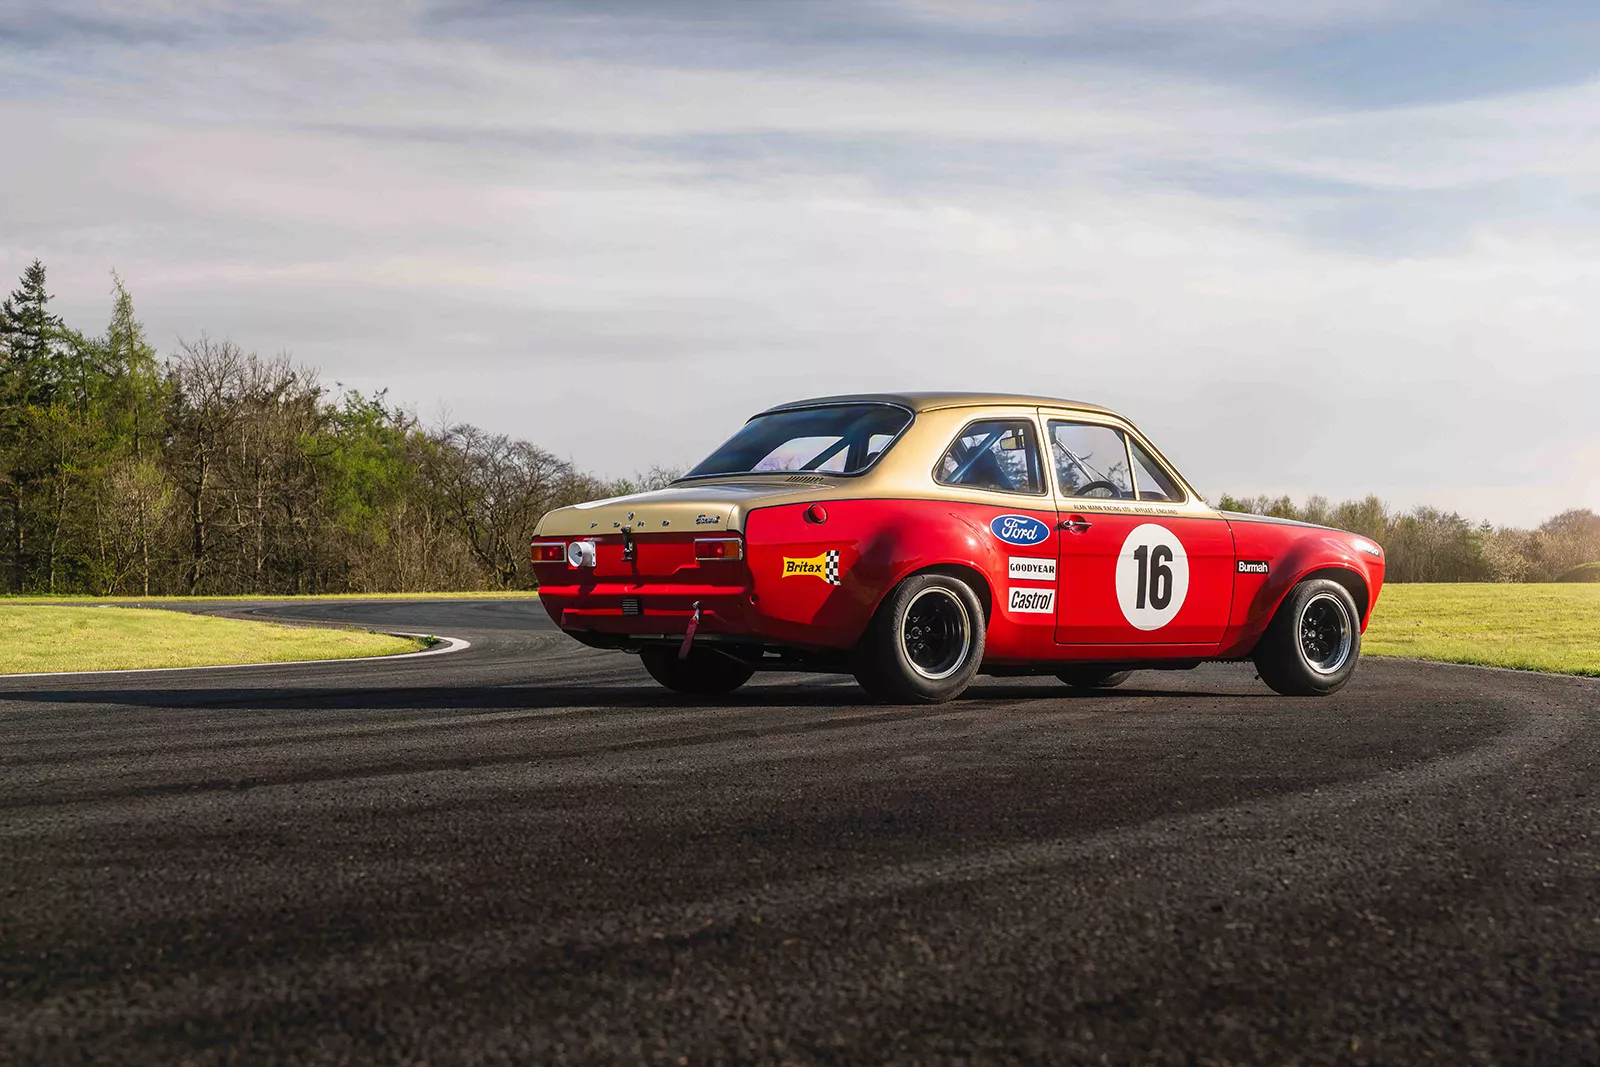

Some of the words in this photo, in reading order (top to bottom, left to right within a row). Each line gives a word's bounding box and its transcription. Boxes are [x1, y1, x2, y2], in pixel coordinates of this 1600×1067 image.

[1001, 517, 1038, 541] Ford
[786, 561, 822, 573] Britax
[1010, 563, 1055, 574] GOODYEAR
[1238, 561, 1268, 573] Burmah
[1133, 544, 1173, 611] 16
[1011, 590, 1052, 610] Castrol
